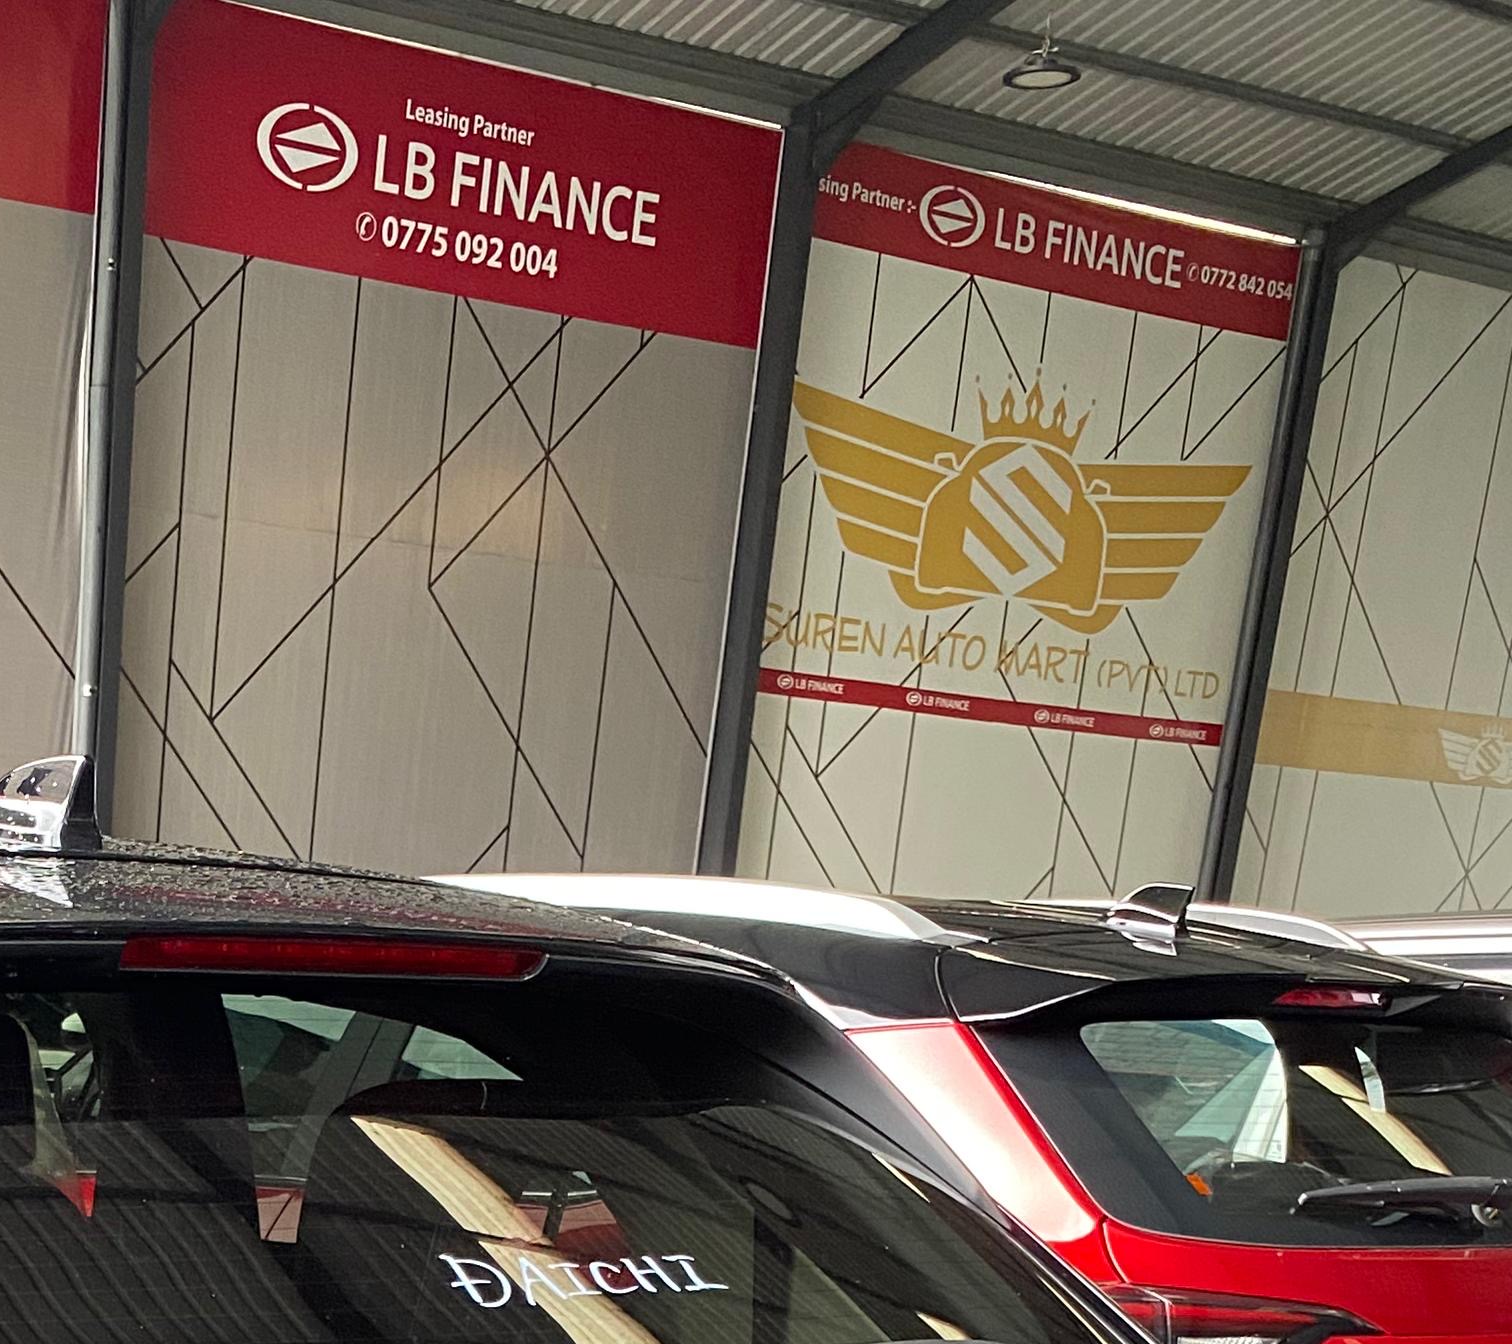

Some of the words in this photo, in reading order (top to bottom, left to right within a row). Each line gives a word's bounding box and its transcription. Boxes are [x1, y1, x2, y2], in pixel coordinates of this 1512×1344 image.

[405, 98, 471, 138] Leasing
[473, 115, 535, 147] Partner
[373, 134, 435, 201] LB
[450, 151, 660, 247] FINANCE
[381, 216, 448, 258] 0775
[454, 230, 503, 269] 092
[509, 242, 558, 279] 004
[994, 208, 1036, 256] LB
[1044, 221, 1185, 289] FINANCE
[1201, 265, 1236, 290] 0772
[1238, 273, 1265, 295] 842
[1267, 280, 1293, 301] 054
[763, 602, 886, 657] SUREN
[893, 624, 986, 671] AUTO
[994, 640, 1090, 684] MART
[1097, 659, 1168, 694] (PVT)
[1174, 669, 1220, 699] LTD
[795, 678, 807, 690] LB
[808, 680, 844, 694] FINANCE
[923, 695, 934, 706] LB
[935, 696, 970, 711] FINANCE
[1050, 713, 1061, 724] LB
[1062, 714, 1095, 727] FINANCE
